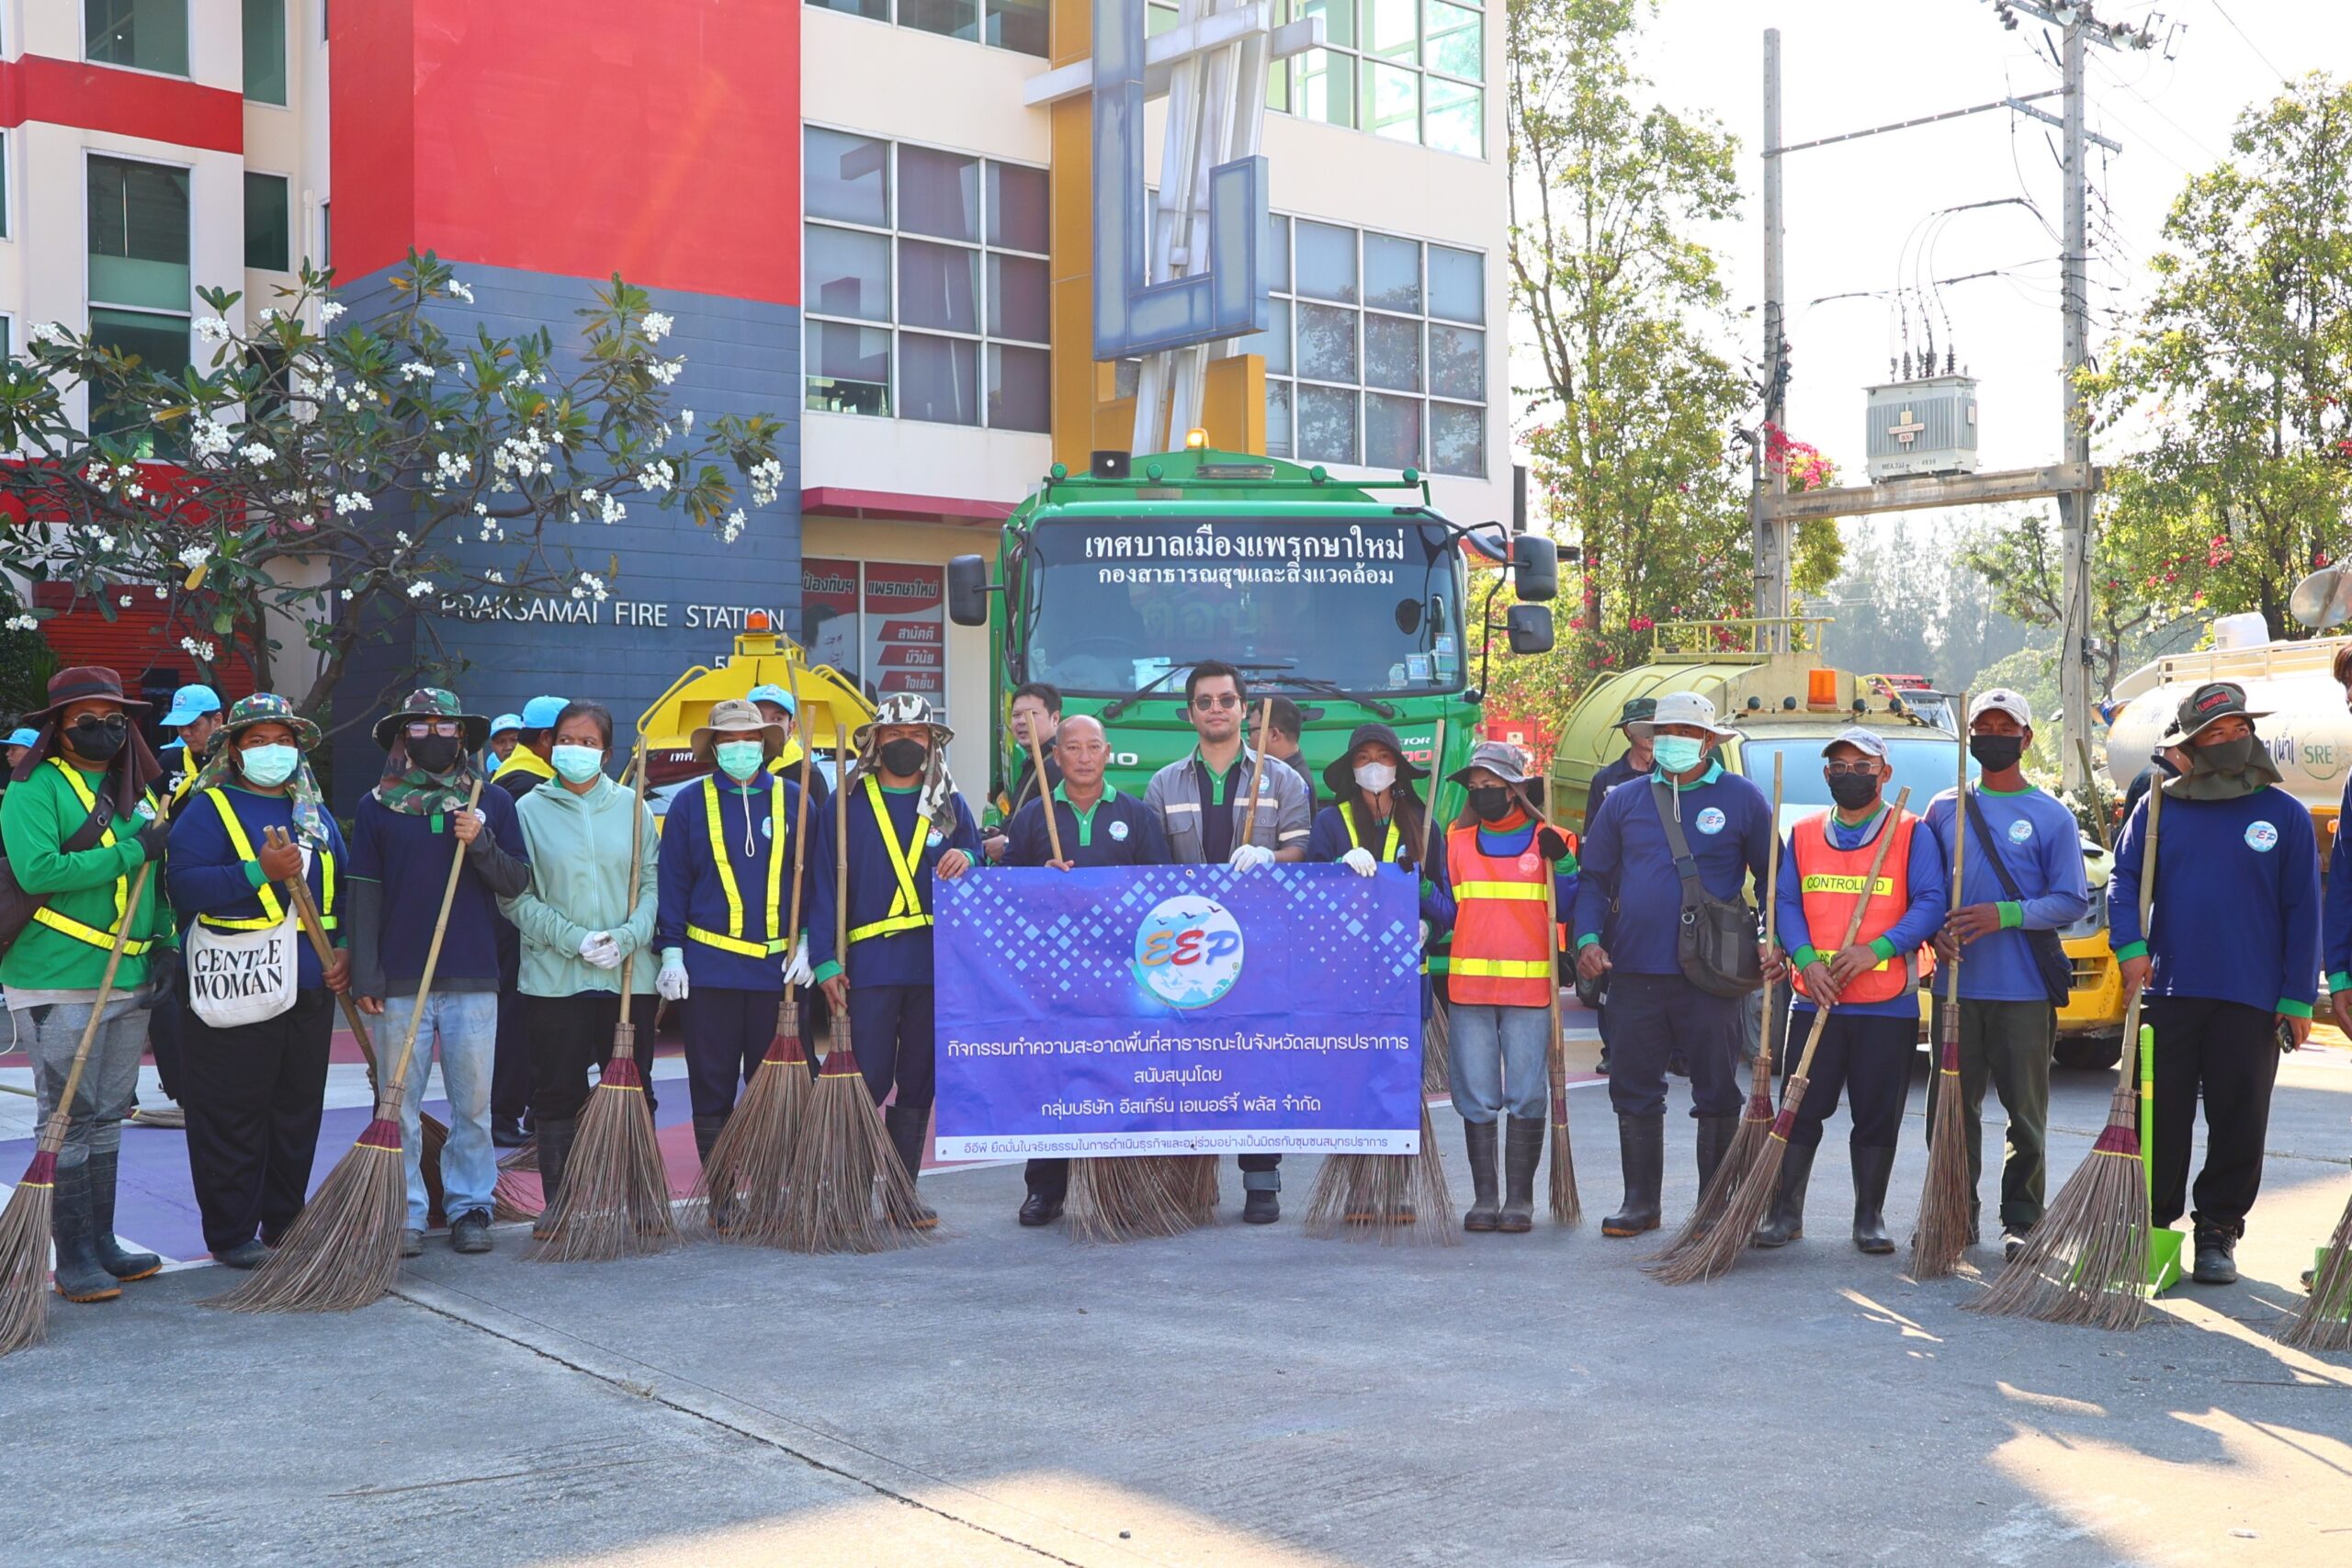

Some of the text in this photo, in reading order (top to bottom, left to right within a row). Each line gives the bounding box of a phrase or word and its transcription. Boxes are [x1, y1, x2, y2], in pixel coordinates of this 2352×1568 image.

[1085, 524, 1404, 559] เทศบาลเมืองแพรกษาใหม่
[1098, 558, 1394, 589] กองสาธารณสุขและสิ่งแวดล้อม
[615, 603, 668, 627] FIRE
[898, 626, 934, 640] สามัคคี
[2304, 745, 2334, 764] SRE
[1806, 876, 1885, 892] CONTROLLD
[194, 940, 281, 973] GENTLE
[1141, 930, 1239, 965] EEP
[193, 966, 282, 1000] WOMAN
[947, 1031, 1409, 1056] กิจกรรมทำความสะอาดพื้นที่สาธารณะในจังหวัดสมุทรปราการ
[1134, 1066, 1222, 1088] สนับสนุนโดย
[1041, 1091, 1321, 1121] กลุ่มบริษัท อีสเทิร์น เอเนอร์จี้ พลัส จำกัด
[964, 1142, 988, 1154] อีอีพี
